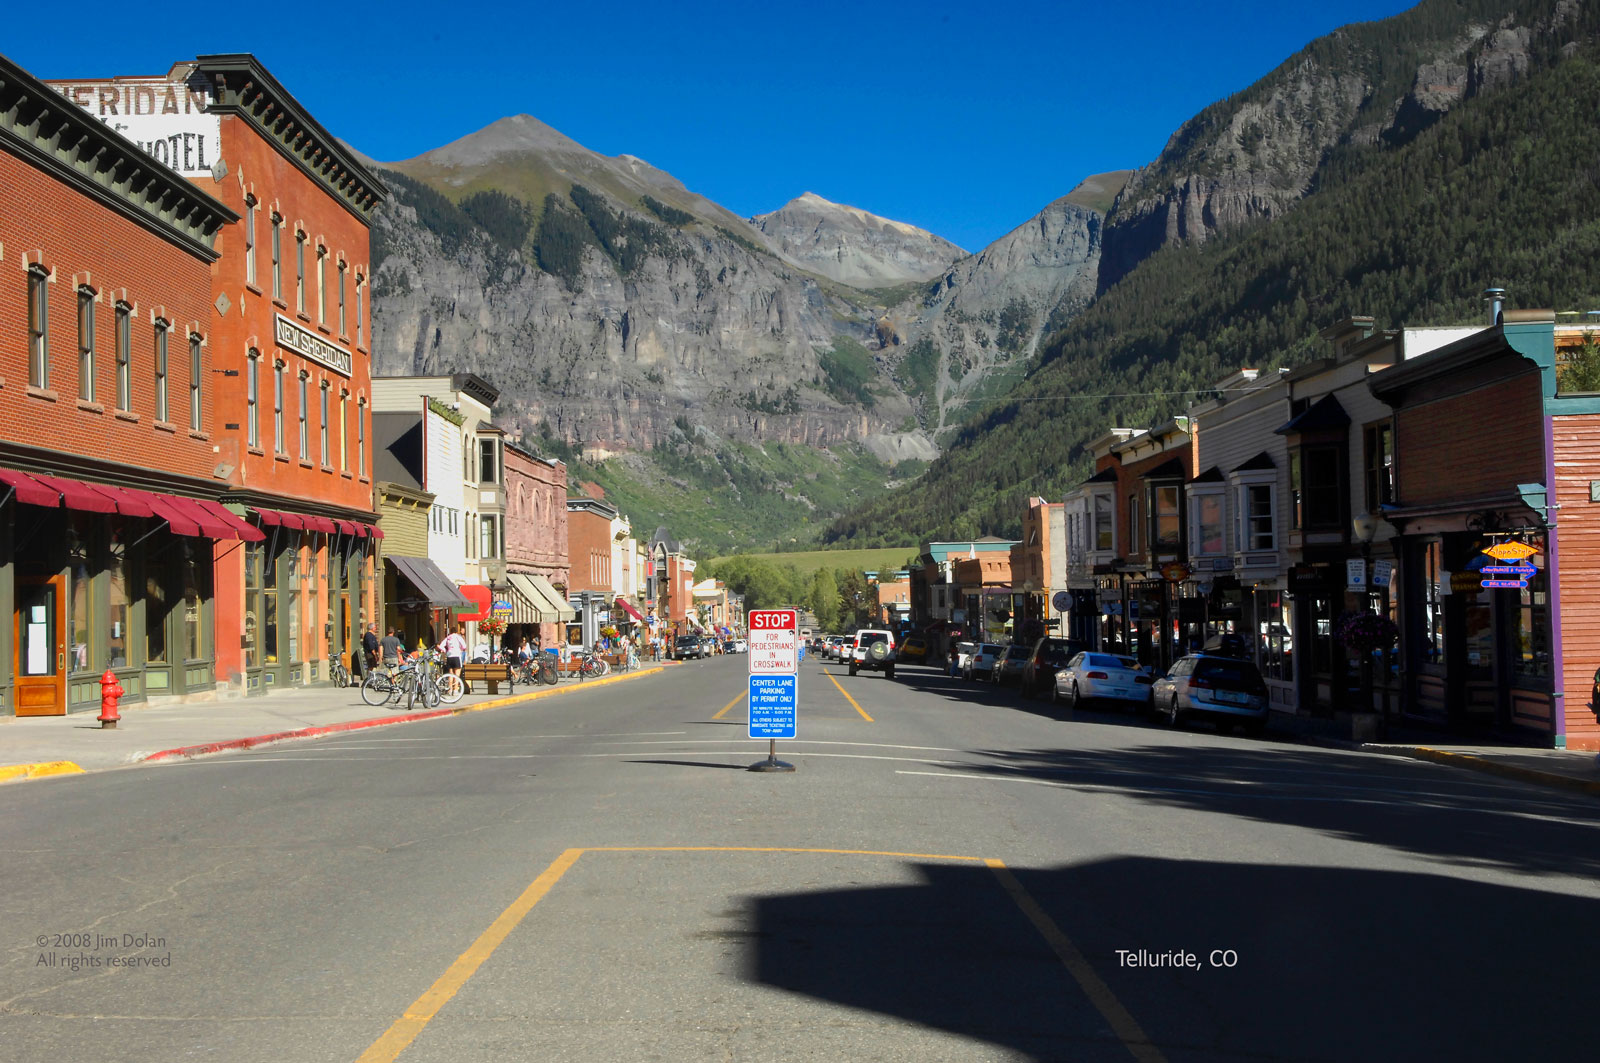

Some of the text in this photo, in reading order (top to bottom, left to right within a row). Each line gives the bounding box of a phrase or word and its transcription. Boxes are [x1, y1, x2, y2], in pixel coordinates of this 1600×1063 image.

[136, 132, 211, 172] HOTEL
[278, 322, 349, 371] NEW SHERIDAN
[754, 614, 790, 628] STOP
